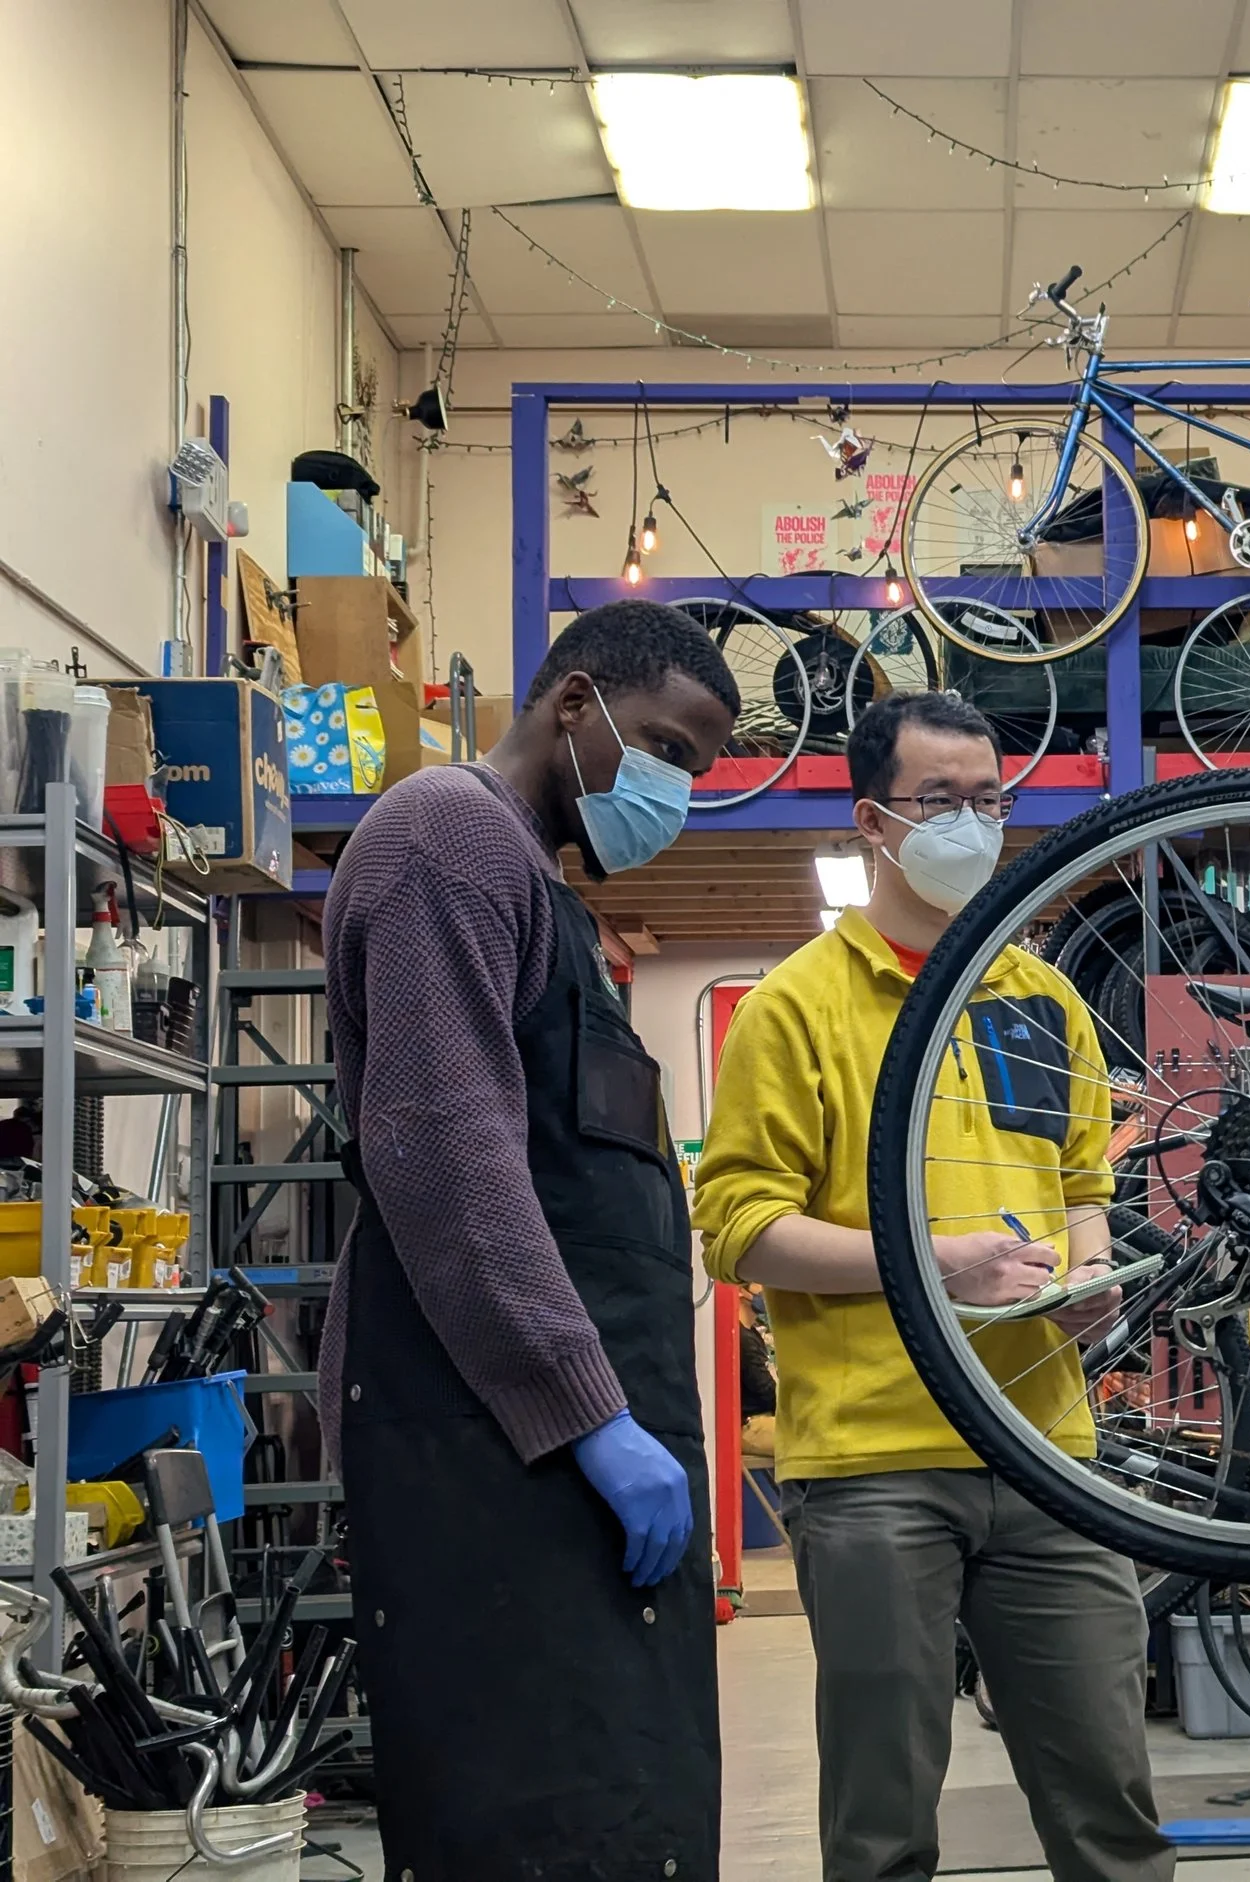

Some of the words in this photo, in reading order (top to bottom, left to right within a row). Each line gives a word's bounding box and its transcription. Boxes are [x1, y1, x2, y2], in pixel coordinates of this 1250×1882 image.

[866, 475, 916, 489] ABOLISH
[867, 490, 883, 501] THE
[775, 516, 825, 531] ABOLISH
[776, 533, 792, 544] THE
[795, 533, 824, 544] POLICE
